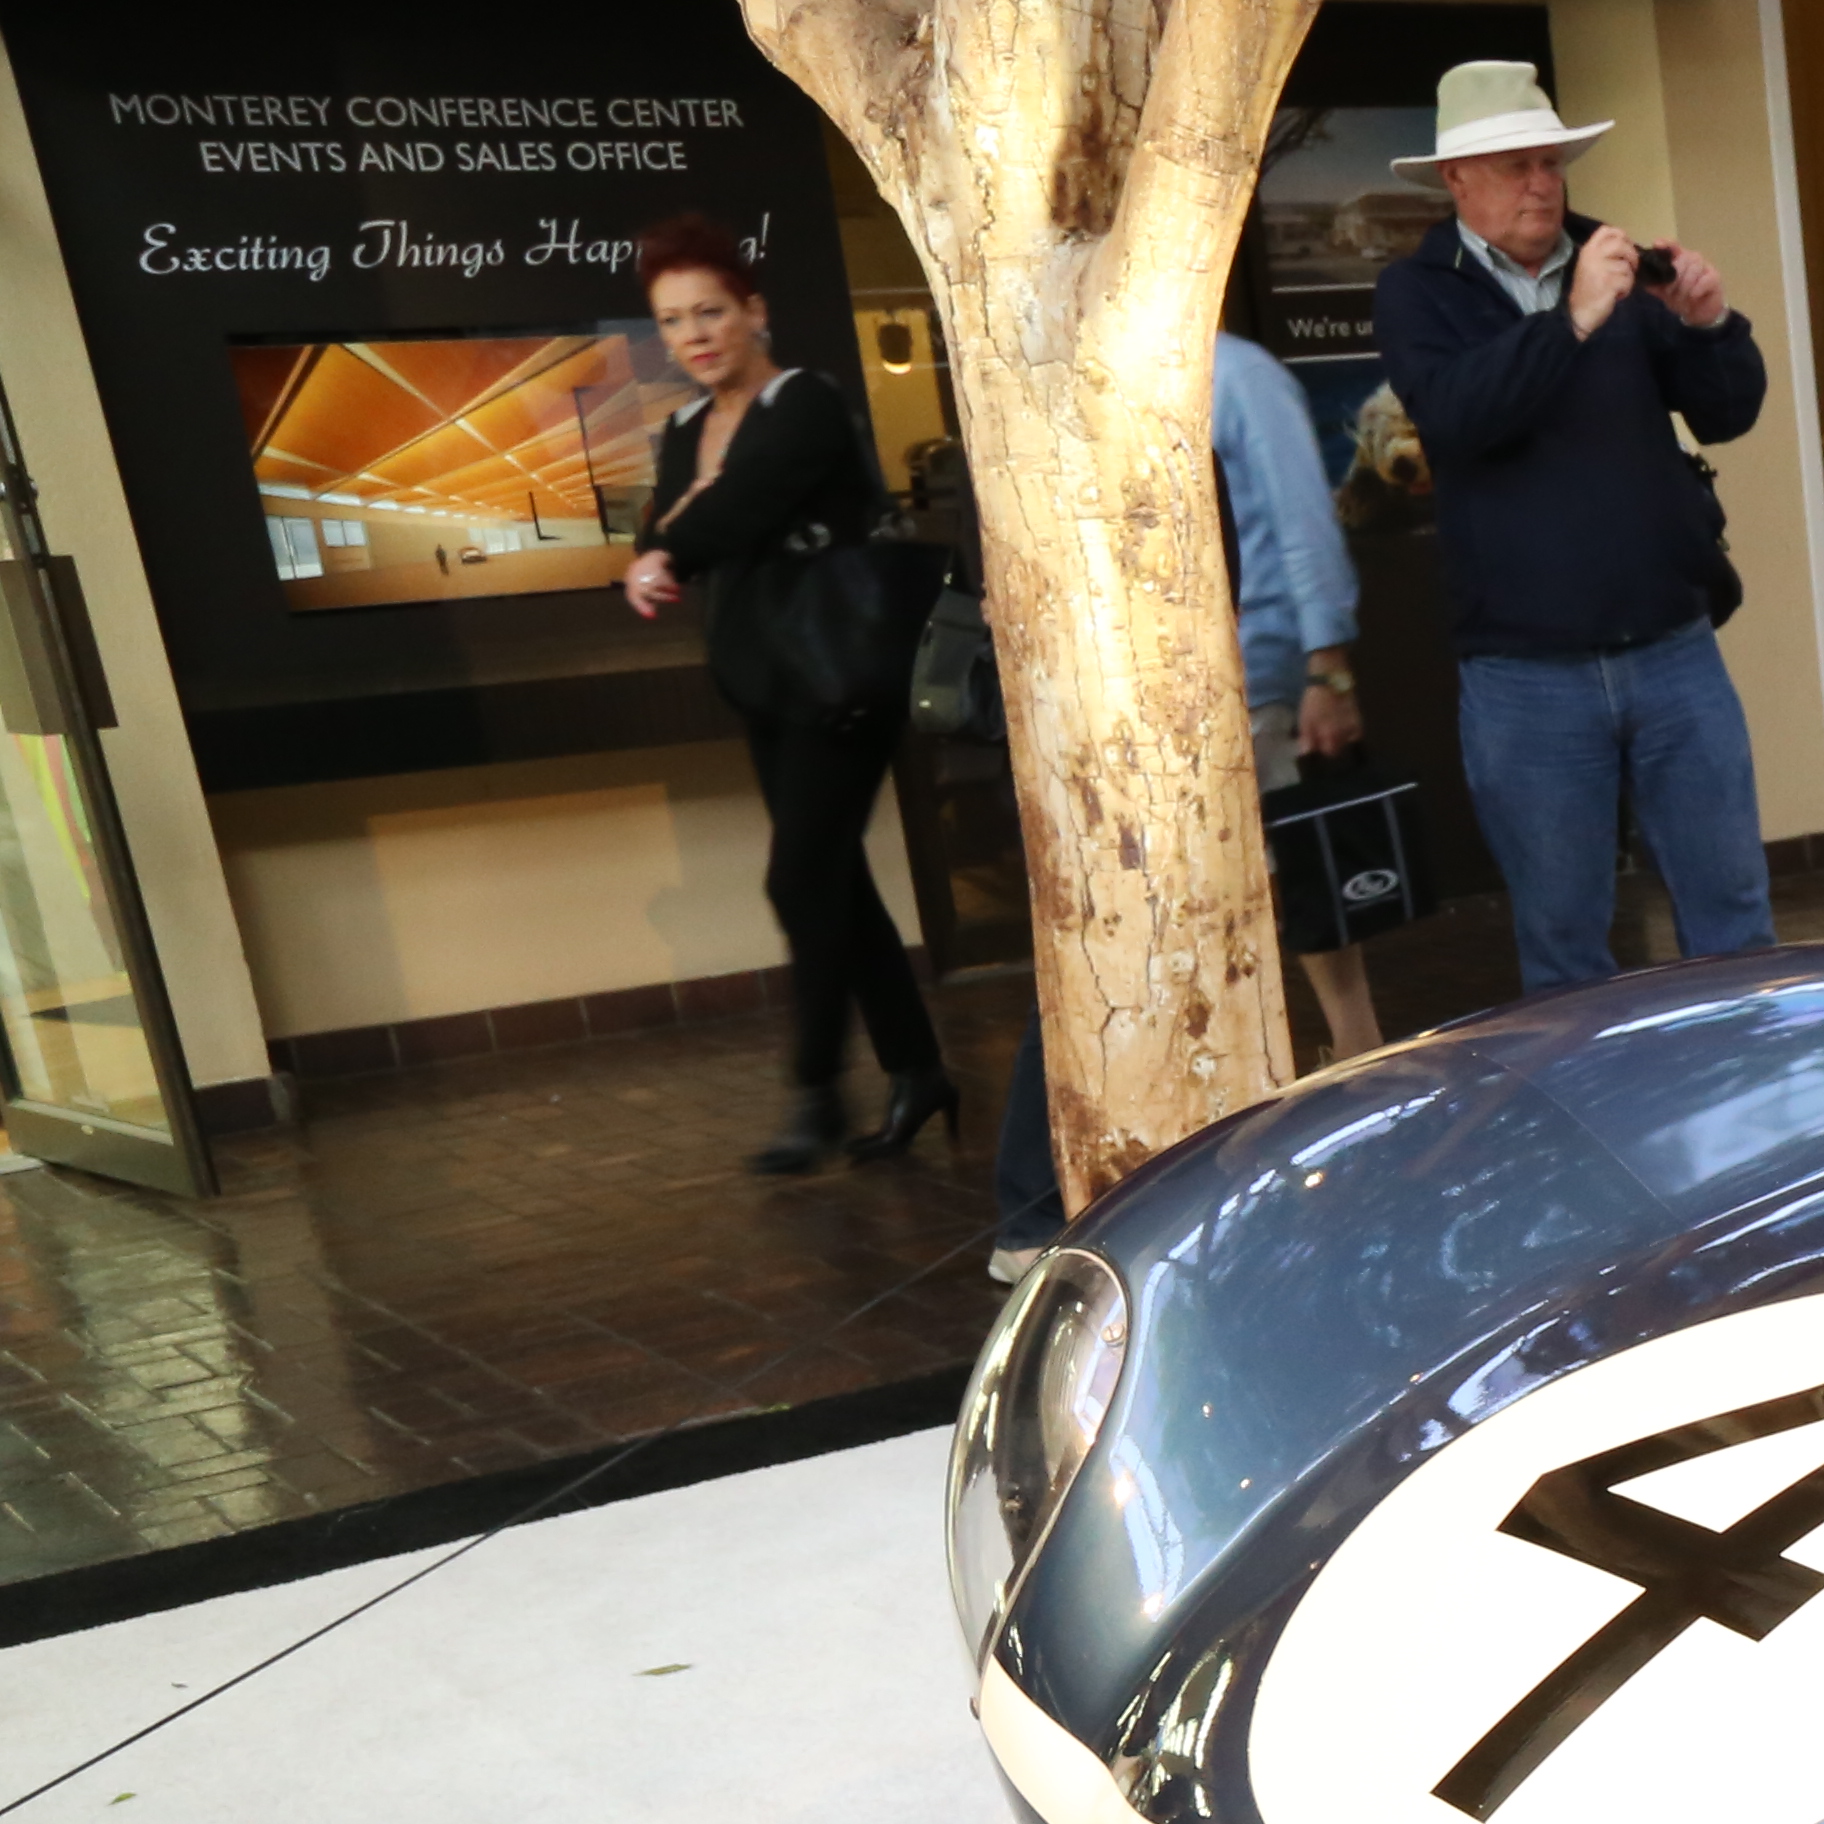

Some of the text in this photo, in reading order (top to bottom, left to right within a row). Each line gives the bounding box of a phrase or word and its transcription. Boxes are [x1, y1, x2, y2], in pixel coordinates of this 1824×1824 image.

[108, 93, 745, 128] MONTEREY CONFERENCE CENTER
[199, 141, 688, 173] EVENTS AND SALES OFFICE
[138, 210, 771, 283] Exciting Things Hapg!
[1286, 315, 1352, 339] We're
